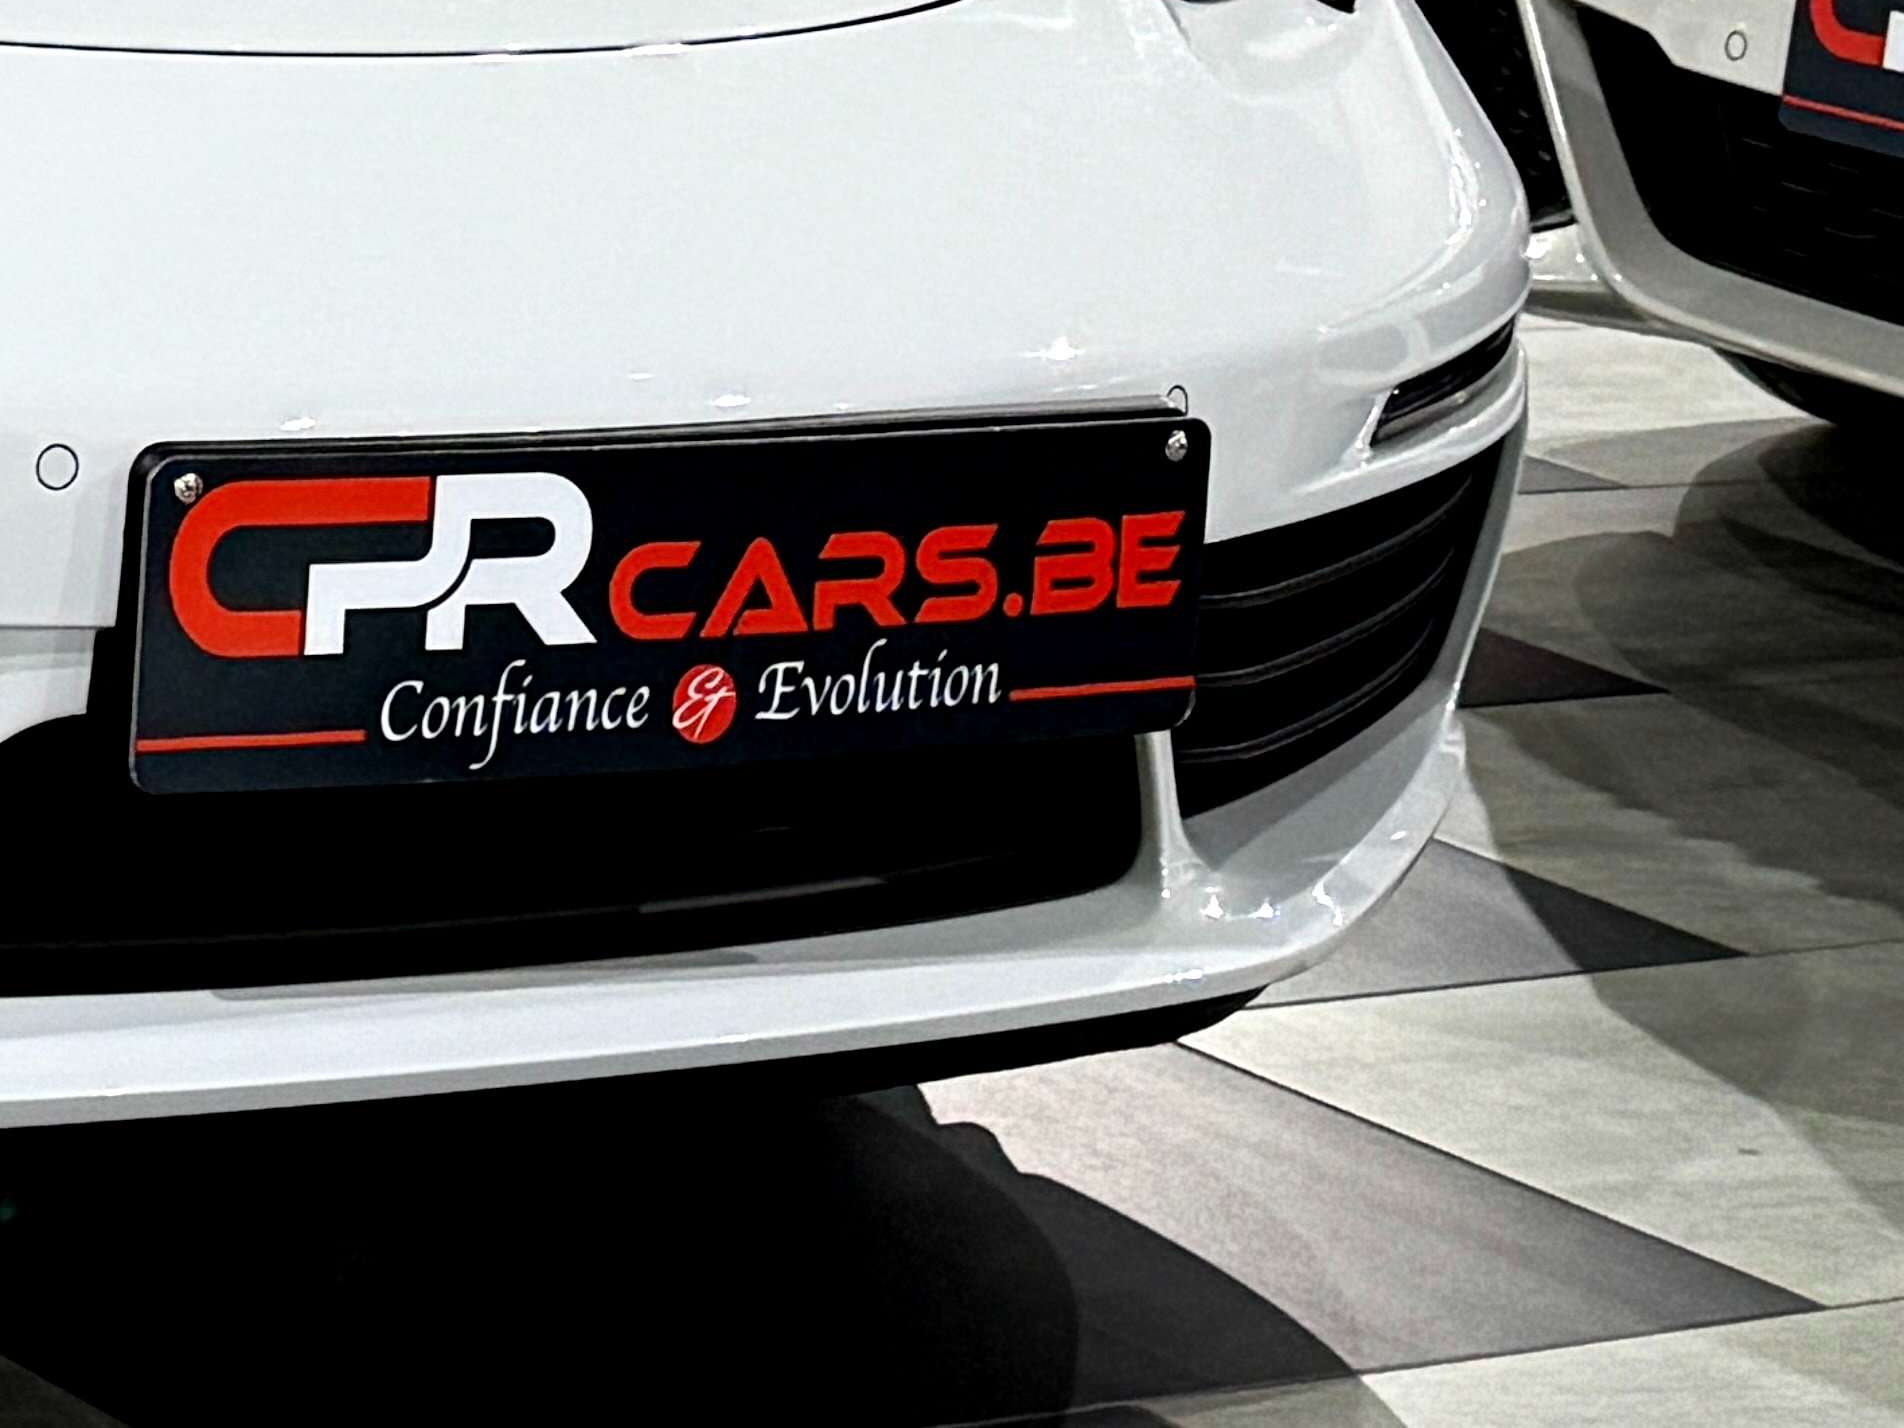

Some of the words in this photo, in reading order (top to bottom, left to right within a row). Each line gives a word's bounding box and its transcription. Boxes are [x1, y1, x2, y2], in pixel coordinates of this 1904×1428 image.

[169, 471, 598, 659] CPR
[608, 510, 1186, 640] CARS.BE
[380, 658, 650, 770] Confiance
[754, 638, 1002, 721] Evolution
